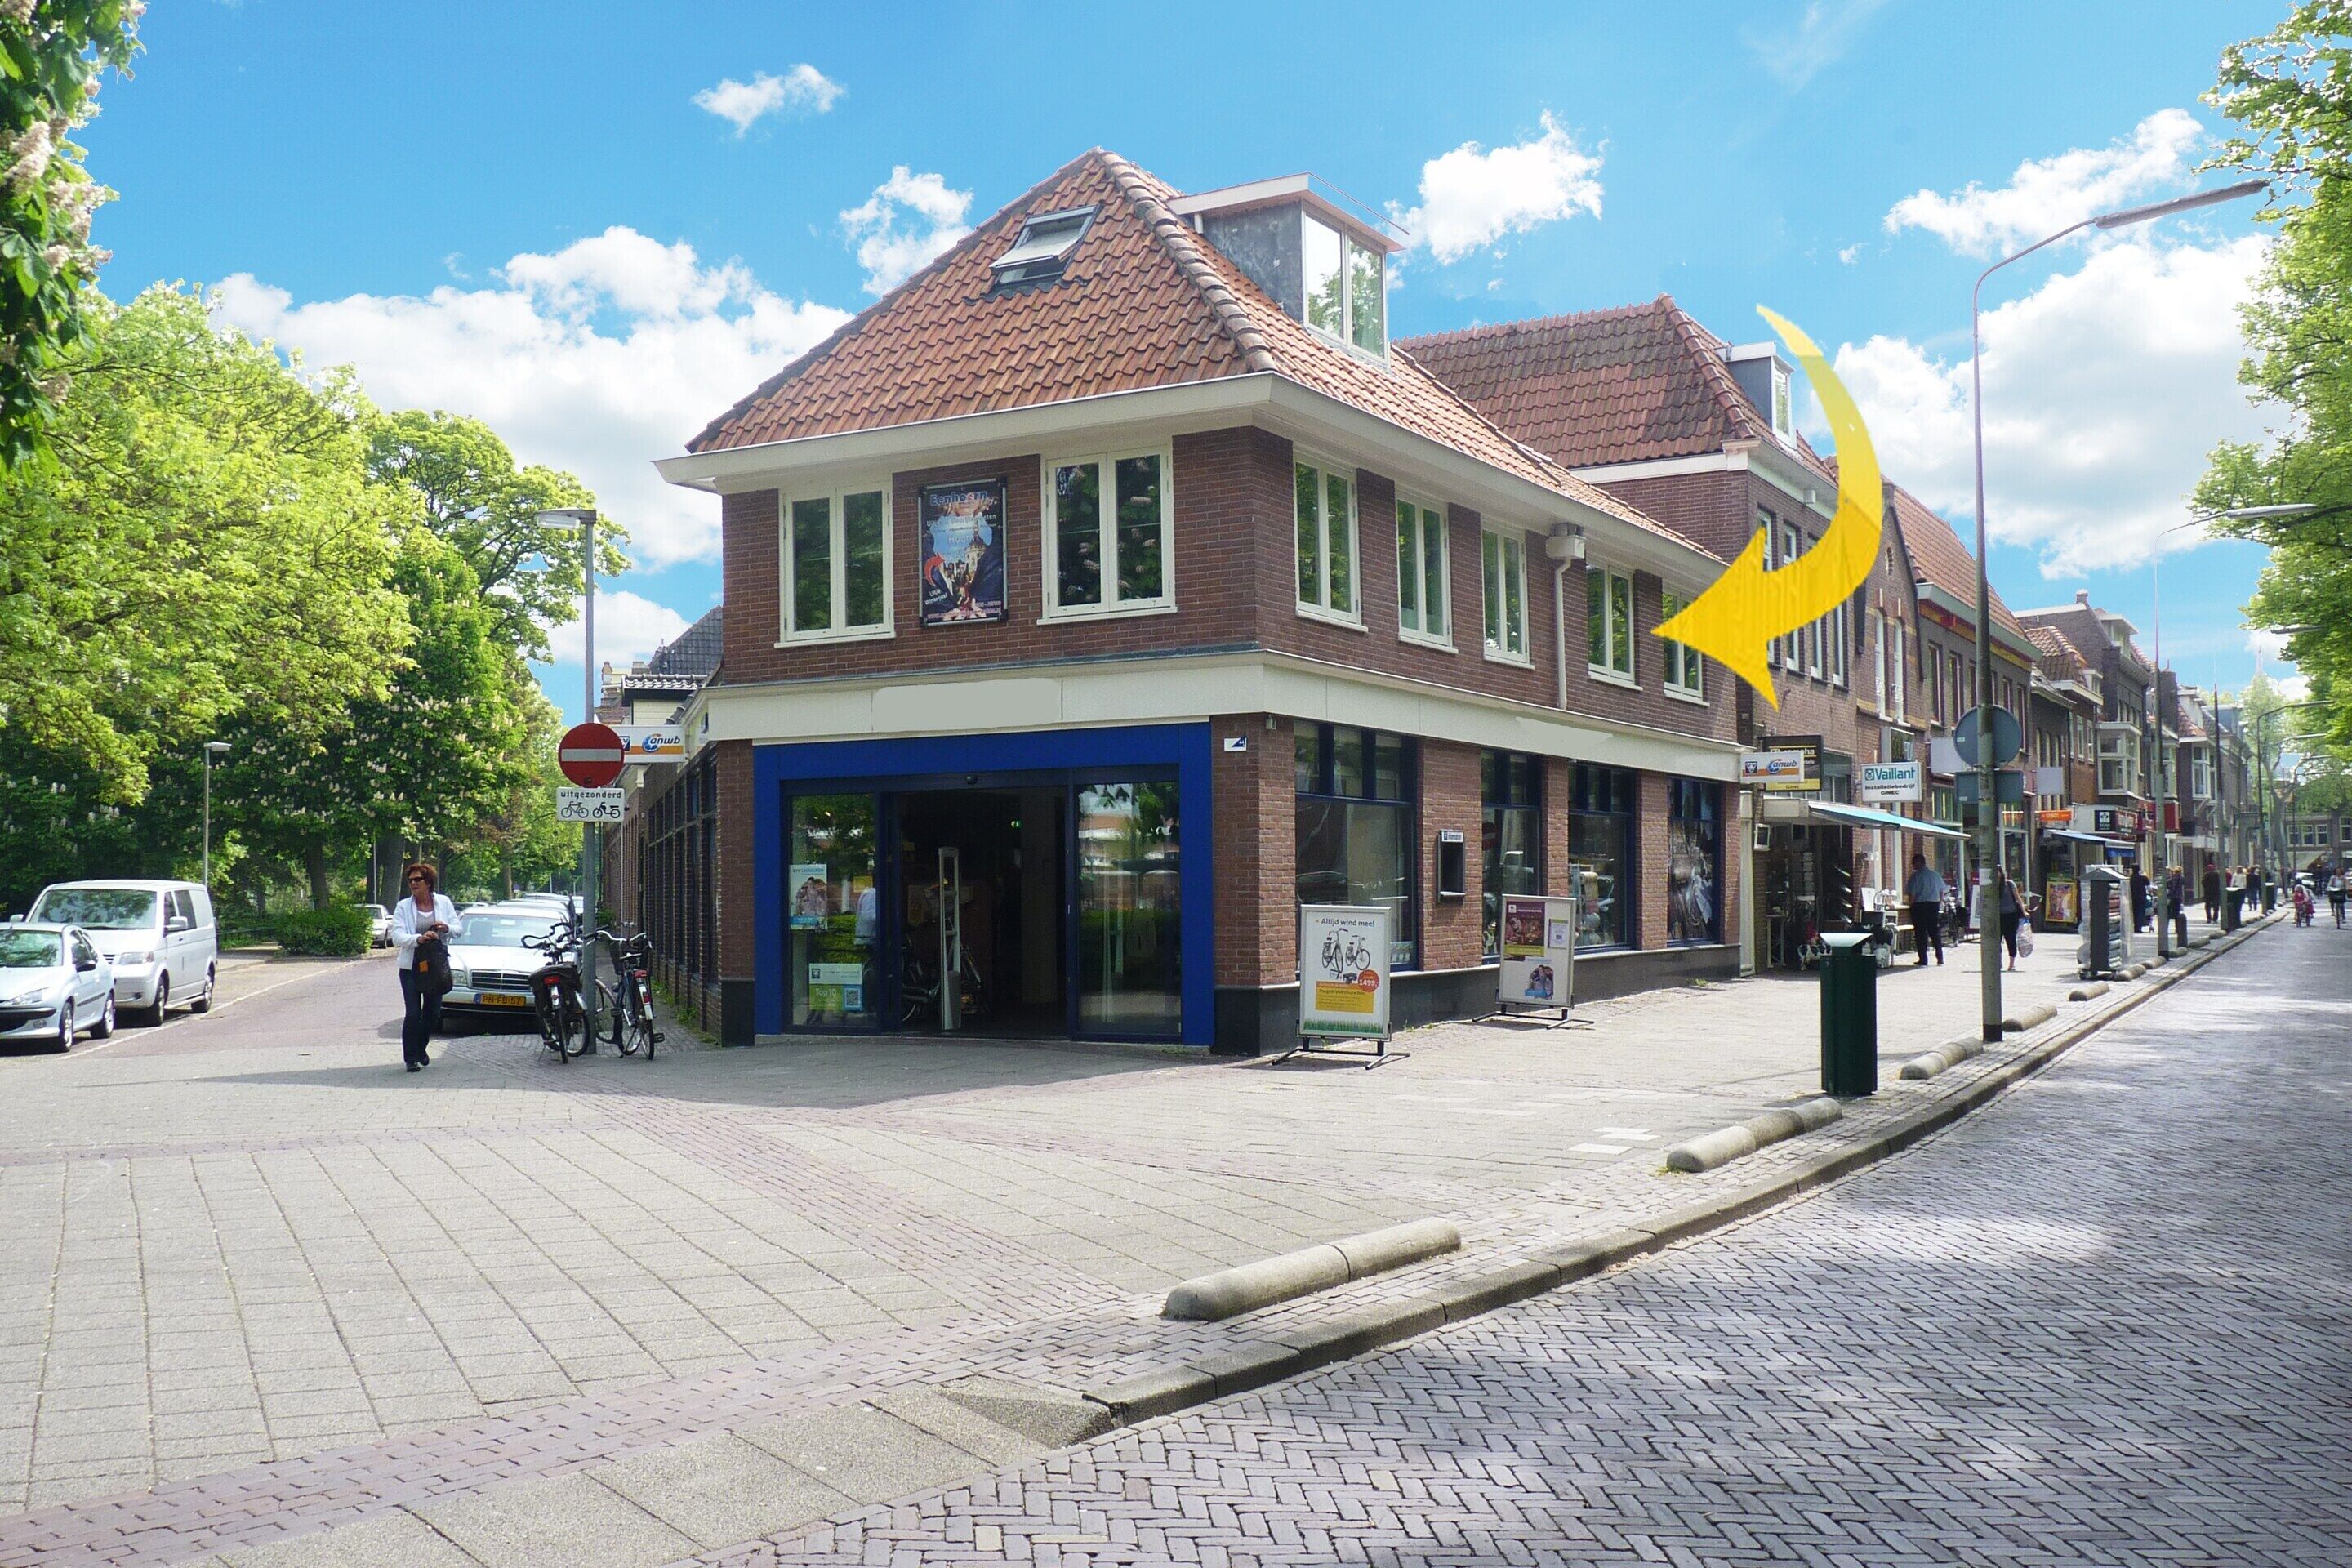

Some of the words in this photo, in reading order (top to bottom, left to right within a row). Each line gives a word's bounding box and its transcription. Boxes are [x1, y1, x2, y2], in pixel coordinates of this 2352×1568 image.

[930, 491, 987, 506] Eenhoorn
[650, 735, 680, 744] anwb
[1875, 767, 1915, 780] Vaillant
[560, 791, 621, 800] uitgezonderd
[1321, 918, 1339, 926] Altijd
[815, 988, 828, 997] Top
